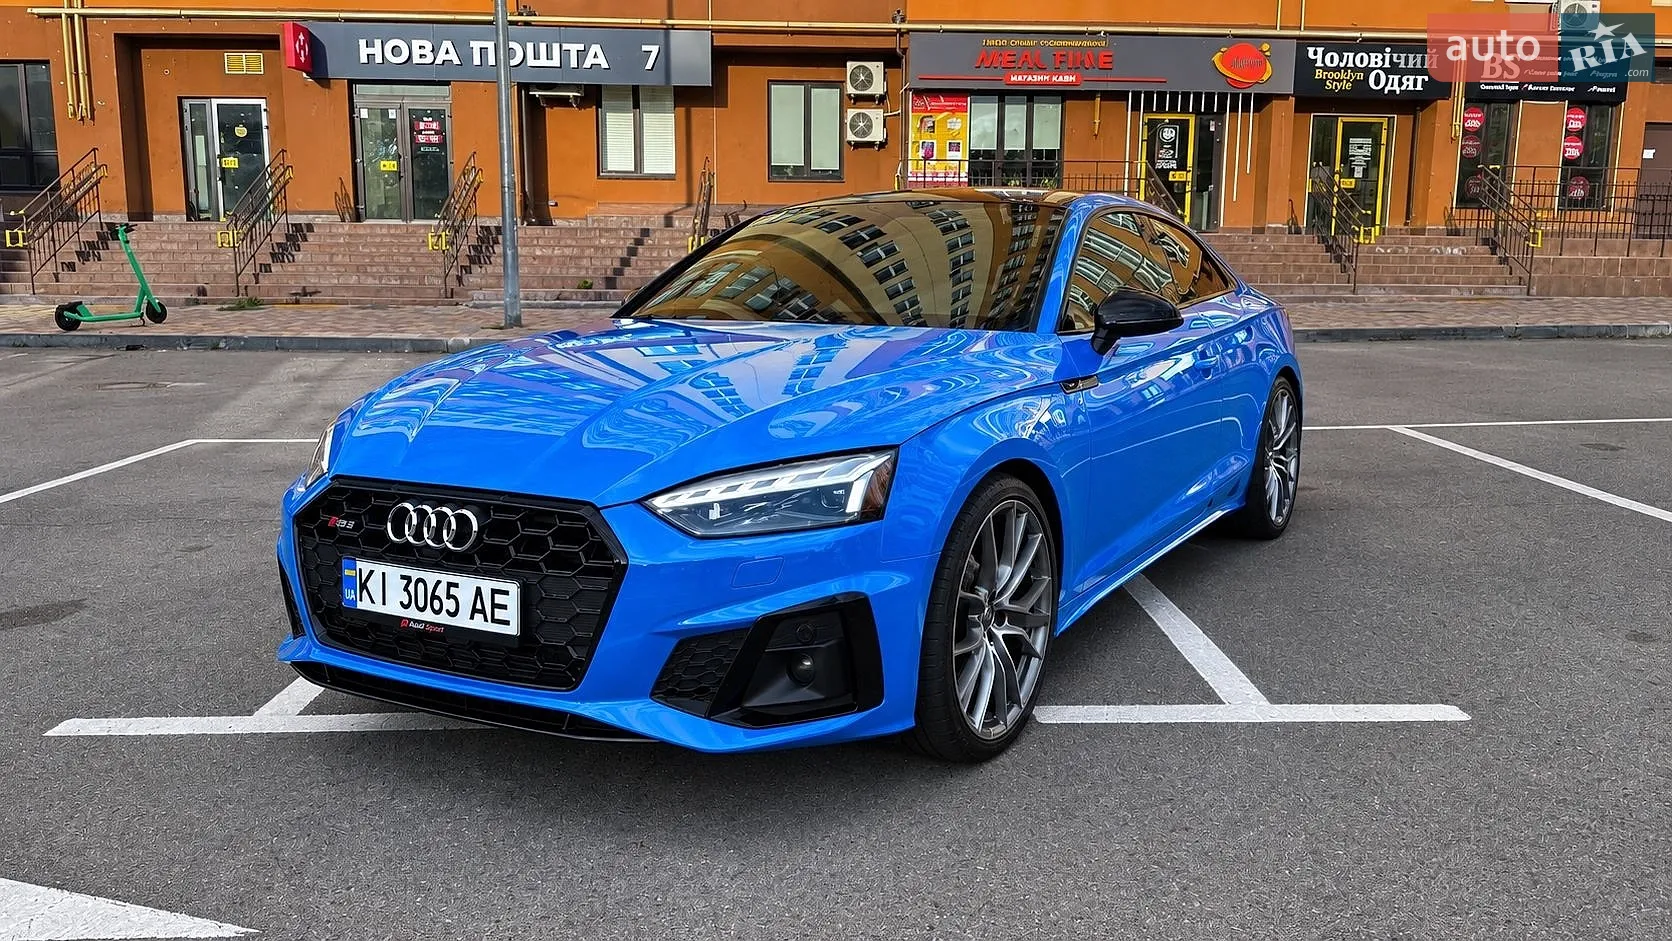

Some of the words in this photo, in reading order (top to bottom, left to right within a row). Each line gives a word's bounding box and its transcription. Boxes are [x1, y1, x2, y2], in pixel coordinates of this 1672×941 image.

[358, 38, 462, 66] НОВА
[470, 40, 610, 69] ПОШТА
[641, 44, 661, 70] 7
[1306, 46, 1440, 69] Чоловічий
[1314, 69, 1364, 81] Brooklyn
[1325, 80, 1352, 92] Style
[1368, 69, 1429, 94] Одяг
[345, 588, 356, 601] UA
[358, 567, 386, 606] KI
[399, 574, 460, 618] 3065
[469, 585, 510, 627] AE
